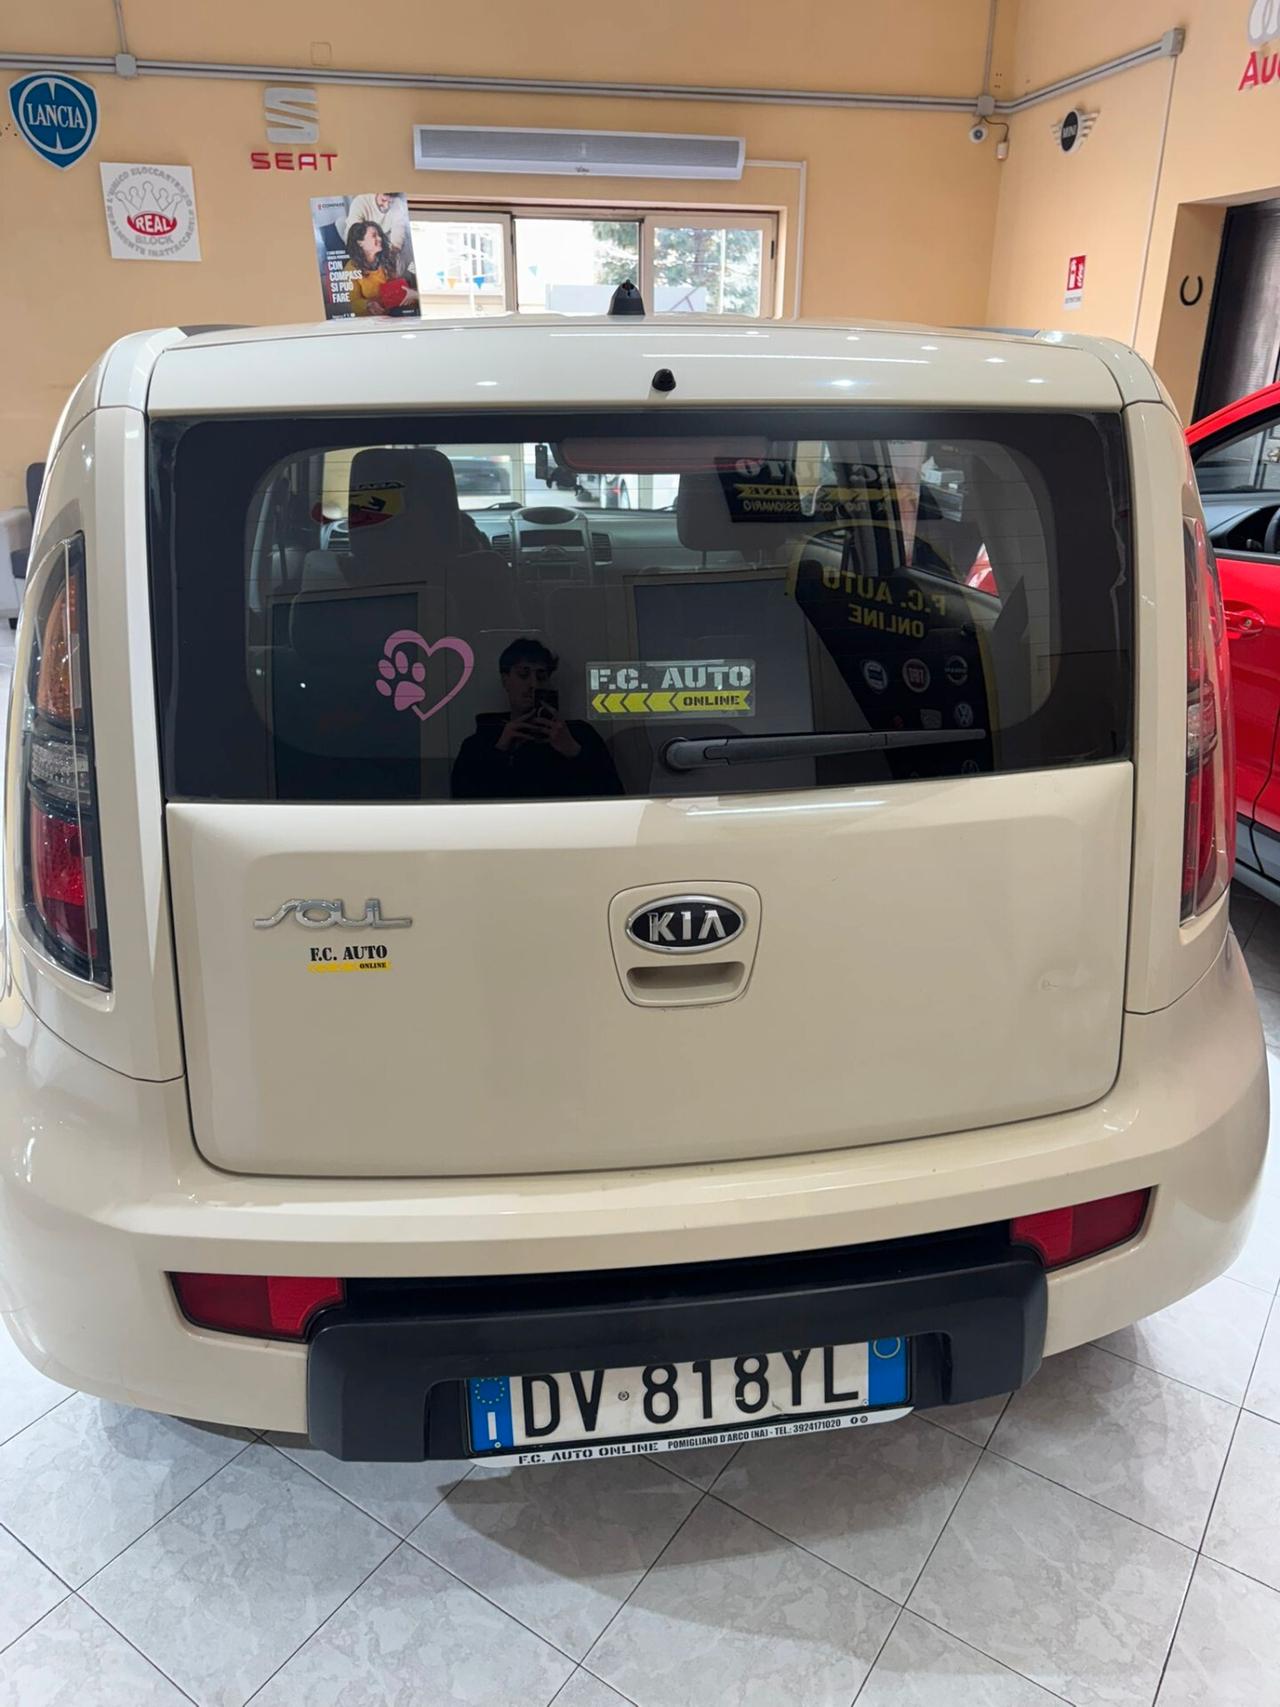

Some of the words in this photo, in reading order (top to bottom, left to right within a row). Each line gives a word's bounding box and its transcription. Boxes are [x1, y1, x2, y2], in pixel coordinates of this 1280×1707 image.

[1238, 50, 1280, 91] AU
[26, 103, 85, 129] LANCIA
[250, 152, 338, 171] SEAT
[135, 214, 171, 233] REAL
[328, 261, 343, 271] CON
[329, 270, 363, 282] COMPASS
[331, 283, 339, 292] SI
[332, 293, 351, 304] FARE
[590, 668, 648, 690] F.C.
[660, 665, 751, 690] AUTO
[683, 695, 740, 706] ONLINE
[253, 898, 413, 929] SOUL
[648, 909, 727, 942] KIA
[310, 947, 338, 962] F.C.
[343, 945, 388, 960] AUTO
[359, 961, 387, 970] ONLINE
[521, 1368, 605, 1438] DV
[518, 1453, 546, 1465] F.C.
[551, 1449, 593, 1462] AUTO
[598, 1442, 659, 1457] ONLINE
[667, 1435, 719, 1450] POMIGLIANO
[720, 1431, 750, 1444] D'ARCO
[793, 1418, 842, 1433] 3924171020
